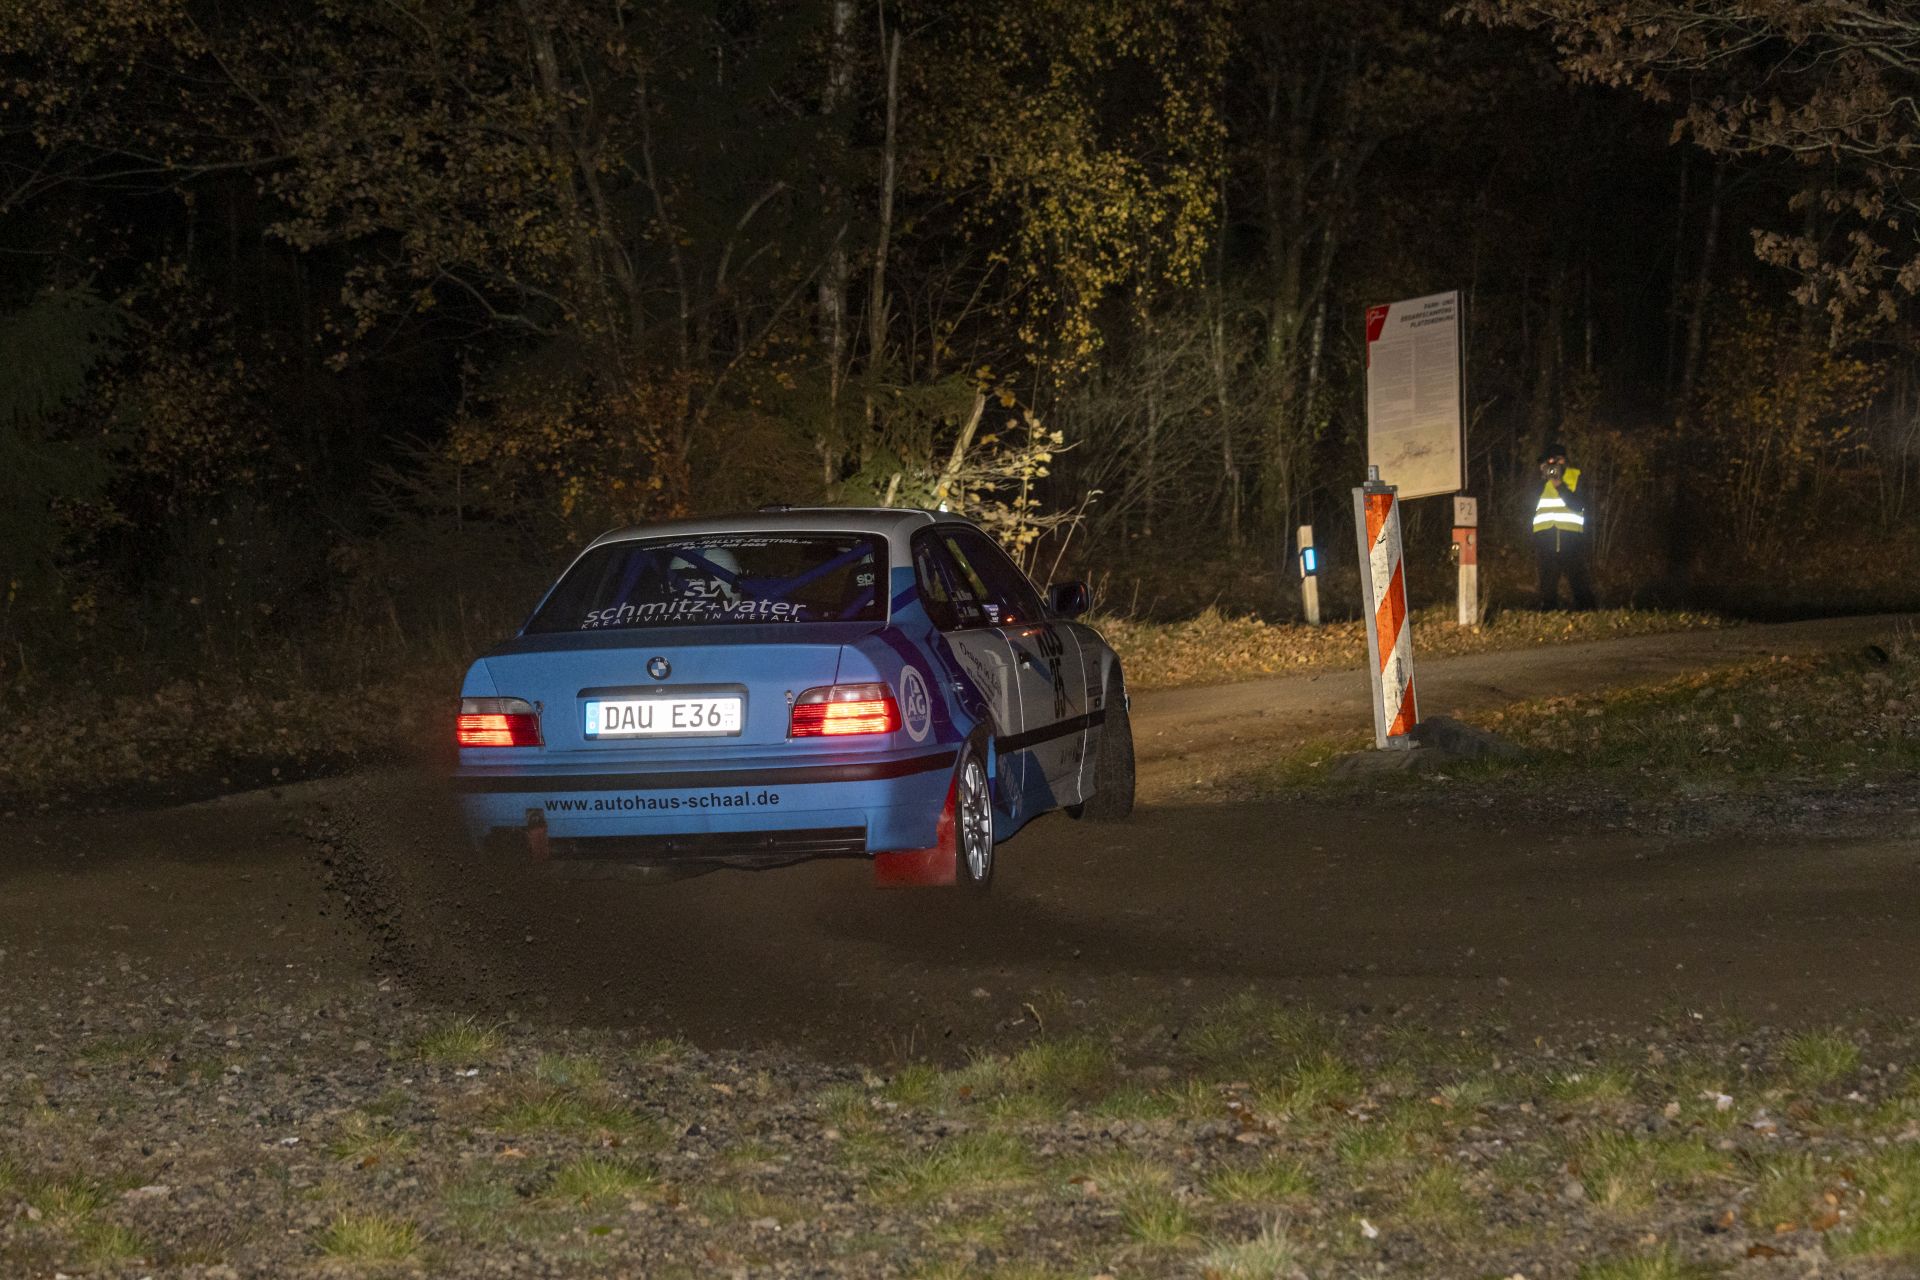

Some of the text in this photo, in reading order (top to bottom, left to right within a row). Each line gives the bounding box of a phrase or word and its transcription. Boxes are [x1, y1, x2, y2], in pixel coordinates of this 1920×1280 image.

[584, 598, 807, 623] schmitz+vater
[733, 613, 801, 623] METALL
[604, 703, 721, 730] DAU E36
[544, 790, 780, 812] www.autohaus-schaal.de
